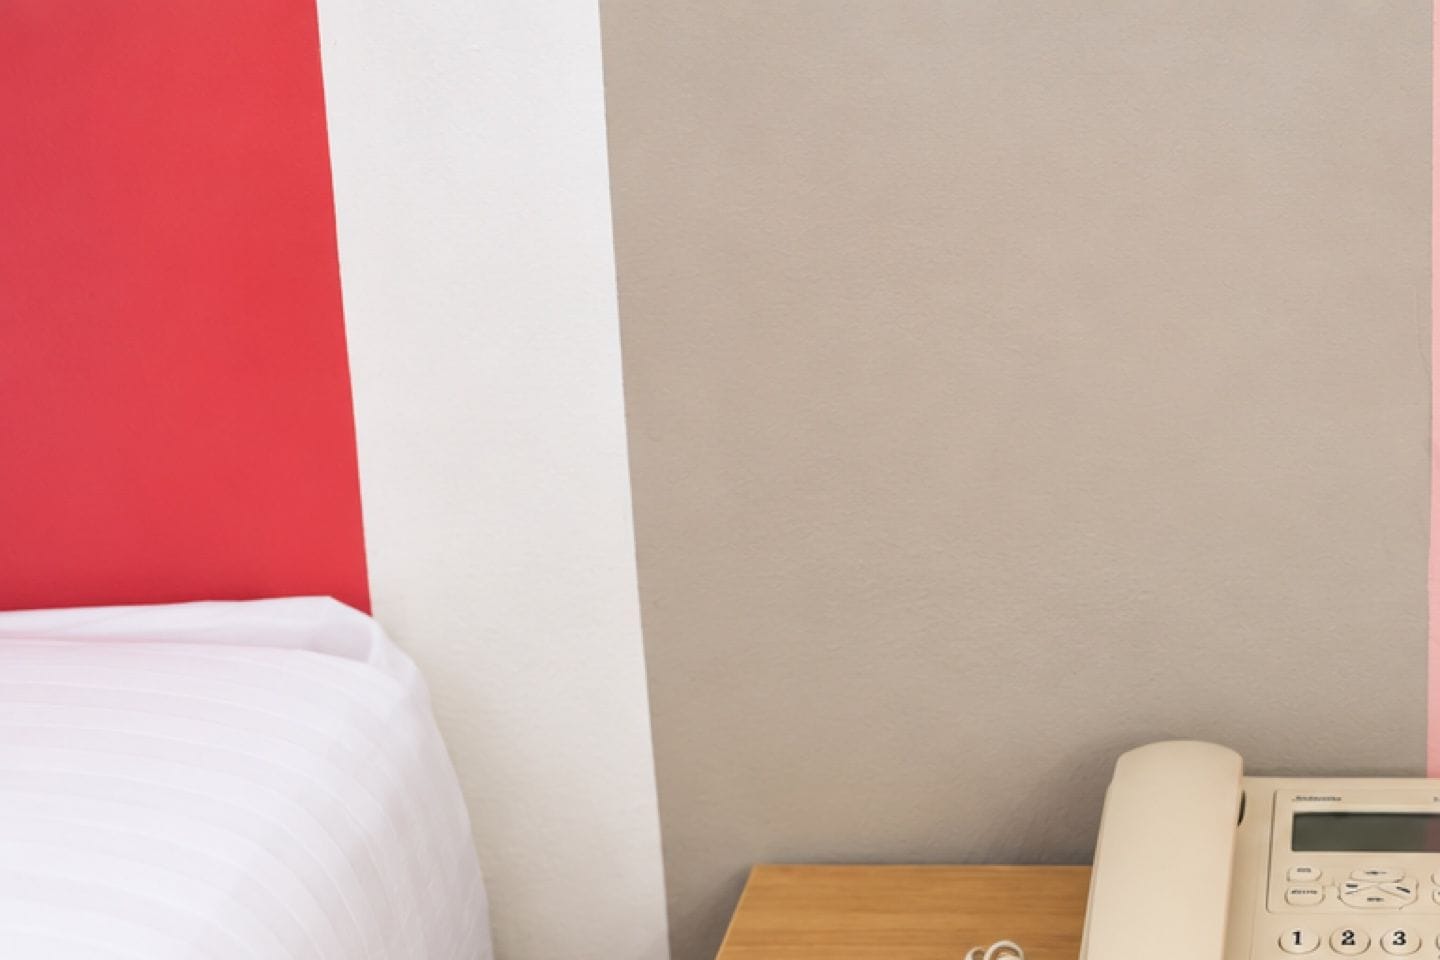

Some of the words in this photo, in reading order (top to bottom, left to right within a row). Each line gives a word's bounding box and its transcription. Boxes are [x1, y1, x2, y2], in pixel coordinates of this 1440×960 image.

[1291, 931, 1302, 946] 1
[1341, 930, 1356, 946] 2
[1393, 931, 1406, 946] 3
